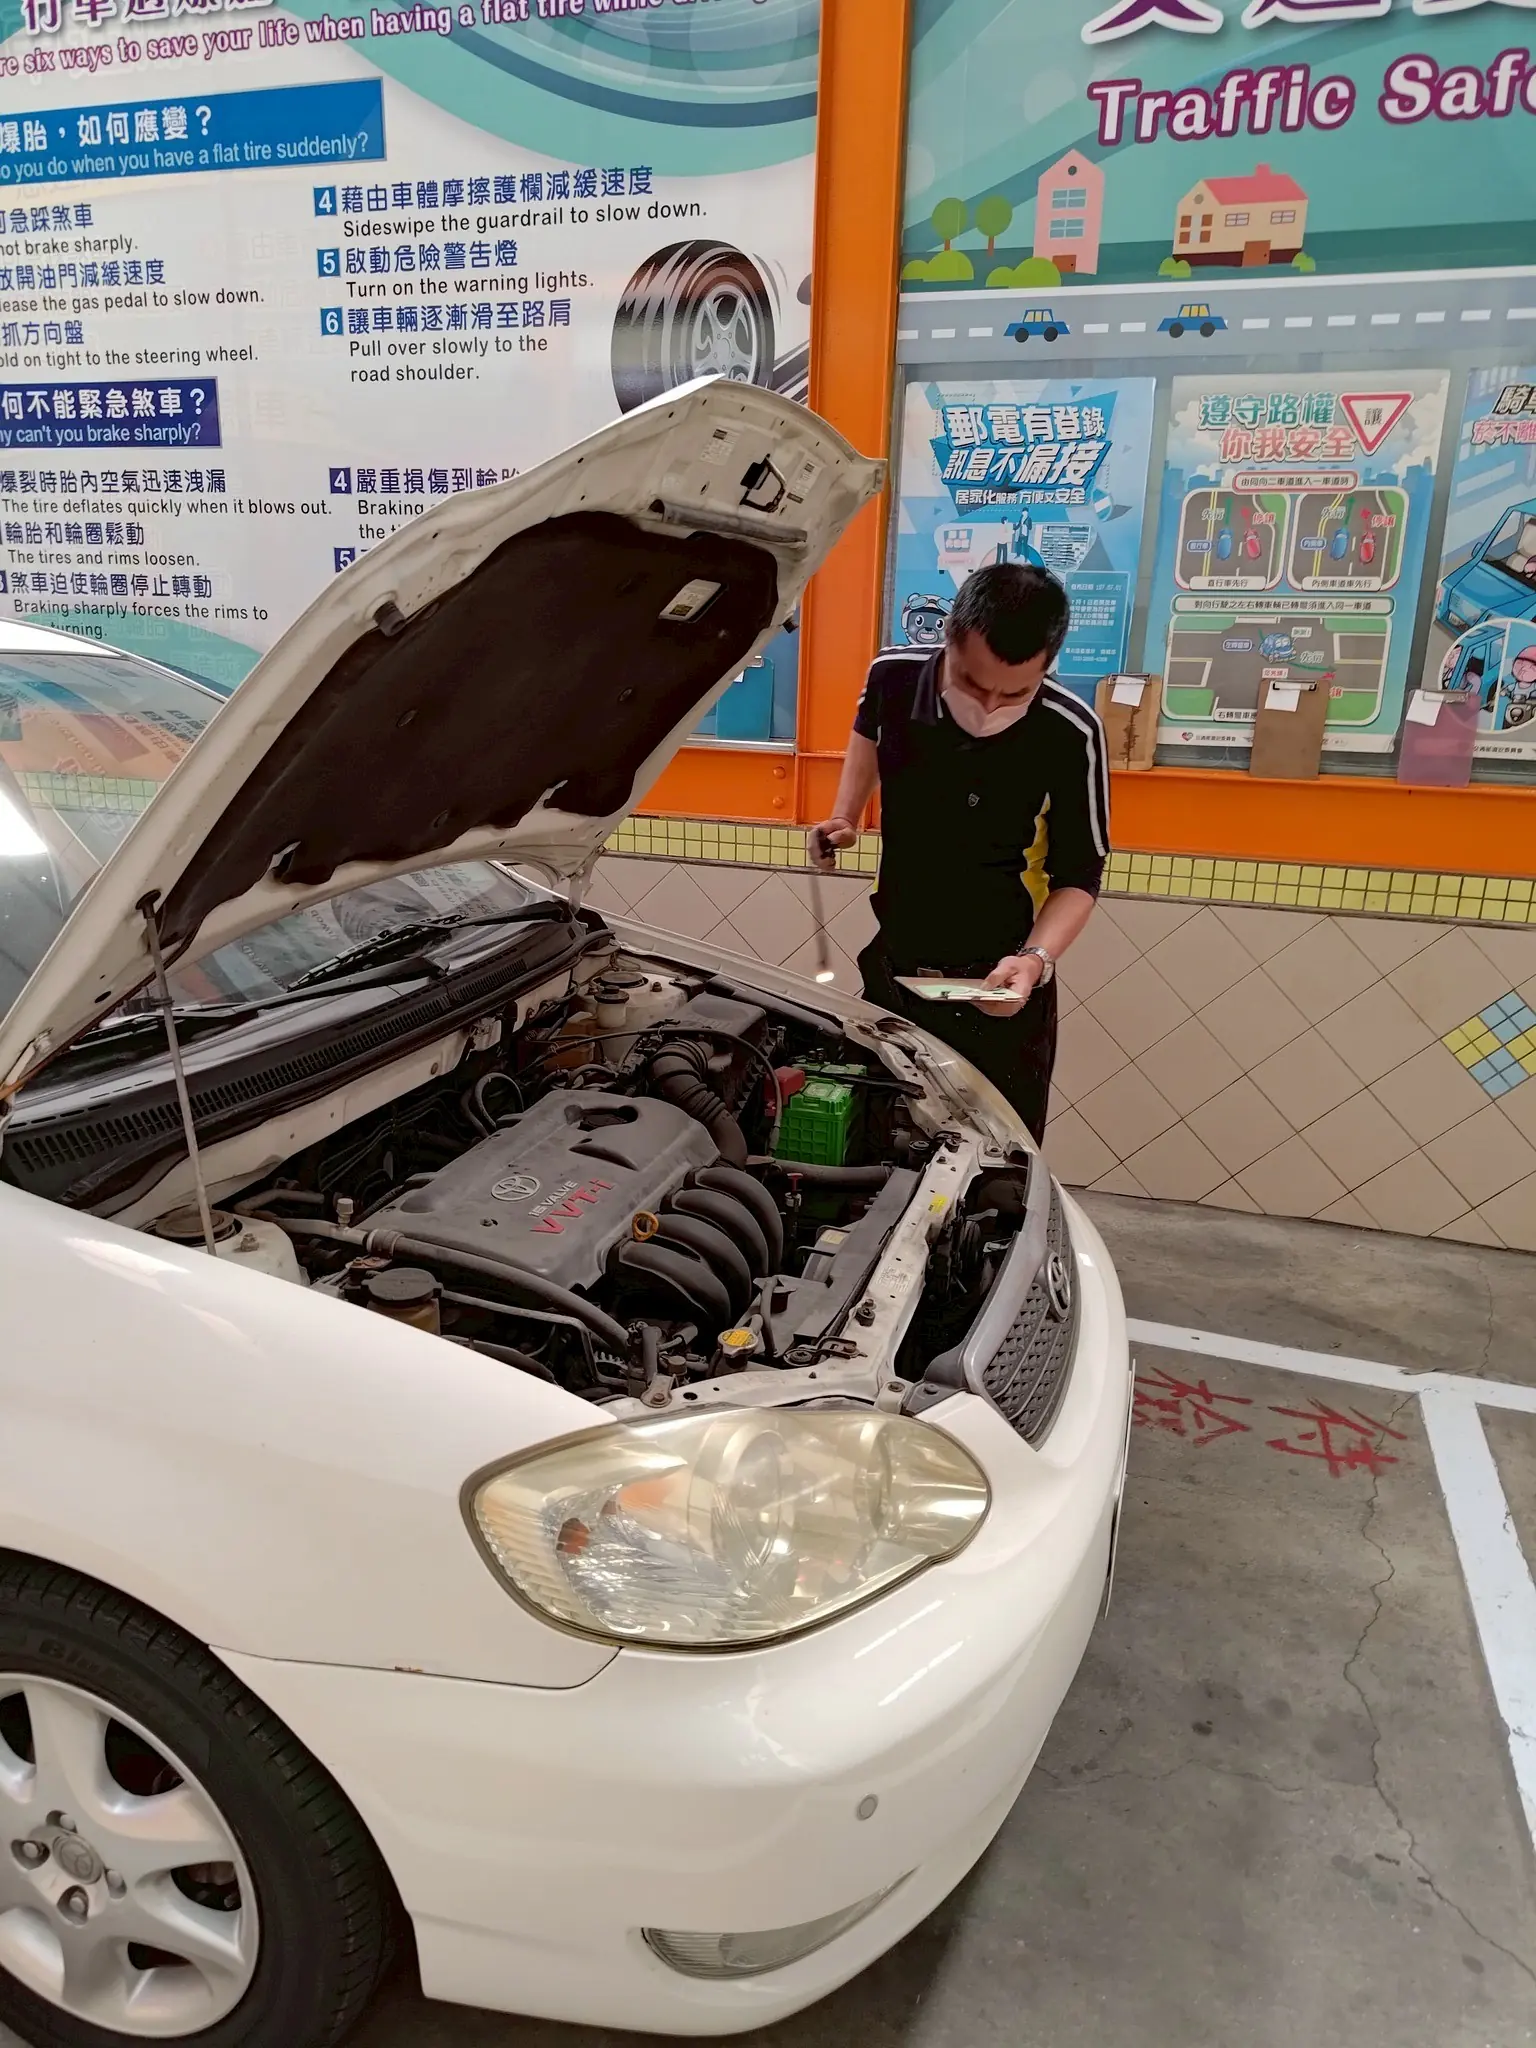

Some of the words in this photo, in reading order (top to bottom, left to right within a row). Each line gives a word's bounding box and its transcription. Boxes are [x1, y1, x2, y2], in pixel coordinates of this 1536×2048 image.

[24, 47, 56, 73] six
[59, 45, 113, 72] ways
[118, 37, 141, 62] to
[147, 34, 198, 60] save
[203, 27, 252, 60] your
[258, 19, 299, 48] life
[305, 15, 365, 44] when
[370, 8, 452, 35] having
[458, 6, 476, 27] a
[480, 0, 529, 25] flat
[1088, 64, 1355, 146] Traffic
[14, 162, 43, 183] you
[48, 156, 68, 175] do
[71, 154, 115, 174] when
[119, 154, 149, 176] you
[154, 146, 194, 168] have
[199, 150, 209, 164] a
[212, 143, 239, 163] flat
[243, 140, 272, 162] tire
[276, 132, 368, 160] suddenly?
[319, 191, 332, 213] 4
[341, 165, 653, 214] 藉由車體摩擦護欄減緩速度
[344, 214, 435, 238] Sideswipe
[441, 212, 469, 231] the
[477, 207, 563, 234] guardrail
[570, 208, 589, 224] to
[596, 206, 640, 223] slow
[647, 201, 707, 220] down.
[25, 238, 69, 255] brake
[74, 234, 138, 254] sharply.
[323, 251, 335, 274] 5
[346, 281, 386, 297] Turn
[394, 282, 413, 296] on
[419, 277, 447, 294] the
[455, 275, 528, 296] warning
[535, 271, 594, 292] lights.
[43, 296, 67, 311] the
[72, 296, 99, 313] gas
[105, 291, 148, 312] pedal
[153, 293, 169, 306] to
[174, 290, 210, 306] slow
[215, 288, 265, 304] down.
[326, 311, 338, 333] 6
[348, 298, 572, 334] 讓車輛逐漸滑至路肩
[24, 355, 41, 367] on
[46, 351, 82, 370] tight
[86, 351, 101, 365] to
[105, 350, 130, 365] the
[135, 348, 201, 366] steering
[205, 345, 259, 362] wheel.
[349, 338, 381, 356] Pull
[388, 339, 426, 355] over
[432, 335, 487, 357] slowly
[495, 338, 513, 352] to
[519, 335, 548, 351] the
[351, 366, 390, 382] road
[396, 363, 480, 382] shoulder.
[1201, 393, 1337, 429] 遵守路權
[1364, 408, 1384, 426] 讓
[16, 425, 52, 442] can't
[55, 428, 83, 446] you
[87, 424, 130, 442] brake
[134, 422, 201, 446] sharply?
[946, 405, 1106, 446] 郵電有登錄
[1221, 426, 1357, 461] 你我安全
[942, 442, 1106, 486] 訊息不漏接
[334, 470, 348, 491] 4
[2, 499, 28, 513] The
[33, 499, 58, 513] tire
[63, 499, 123, 514] deflates
[127, 499, 182, 516] quickly
[186, 499, 228, 514] when
[234, 499, 245, 514] it
[248, 499, 295, 514] blows
[301, 500, 332, 515] out.
[4, 522, 144, 546] 輪胎和輪圈鬆動
[359, 524, 385, 539] the
[8, 550, 34, 564] The
[39, 549, 72, 564] tires
[77, 551, 103, 565] and
[108, 551, 140, 565] rims
[144, 551, 200, 567] loosen.
[11, 572, 212, 599] 煞車迫使輪圈停止轉動
[14, 599, 69, 617] Braking
[75, 601, 127, 618] sharply
[131, 602, 180, 617] forces
[185, 604, 208, 618] the
[214, 605, 248, 620] rims
[253, 606, 268, 620] to
